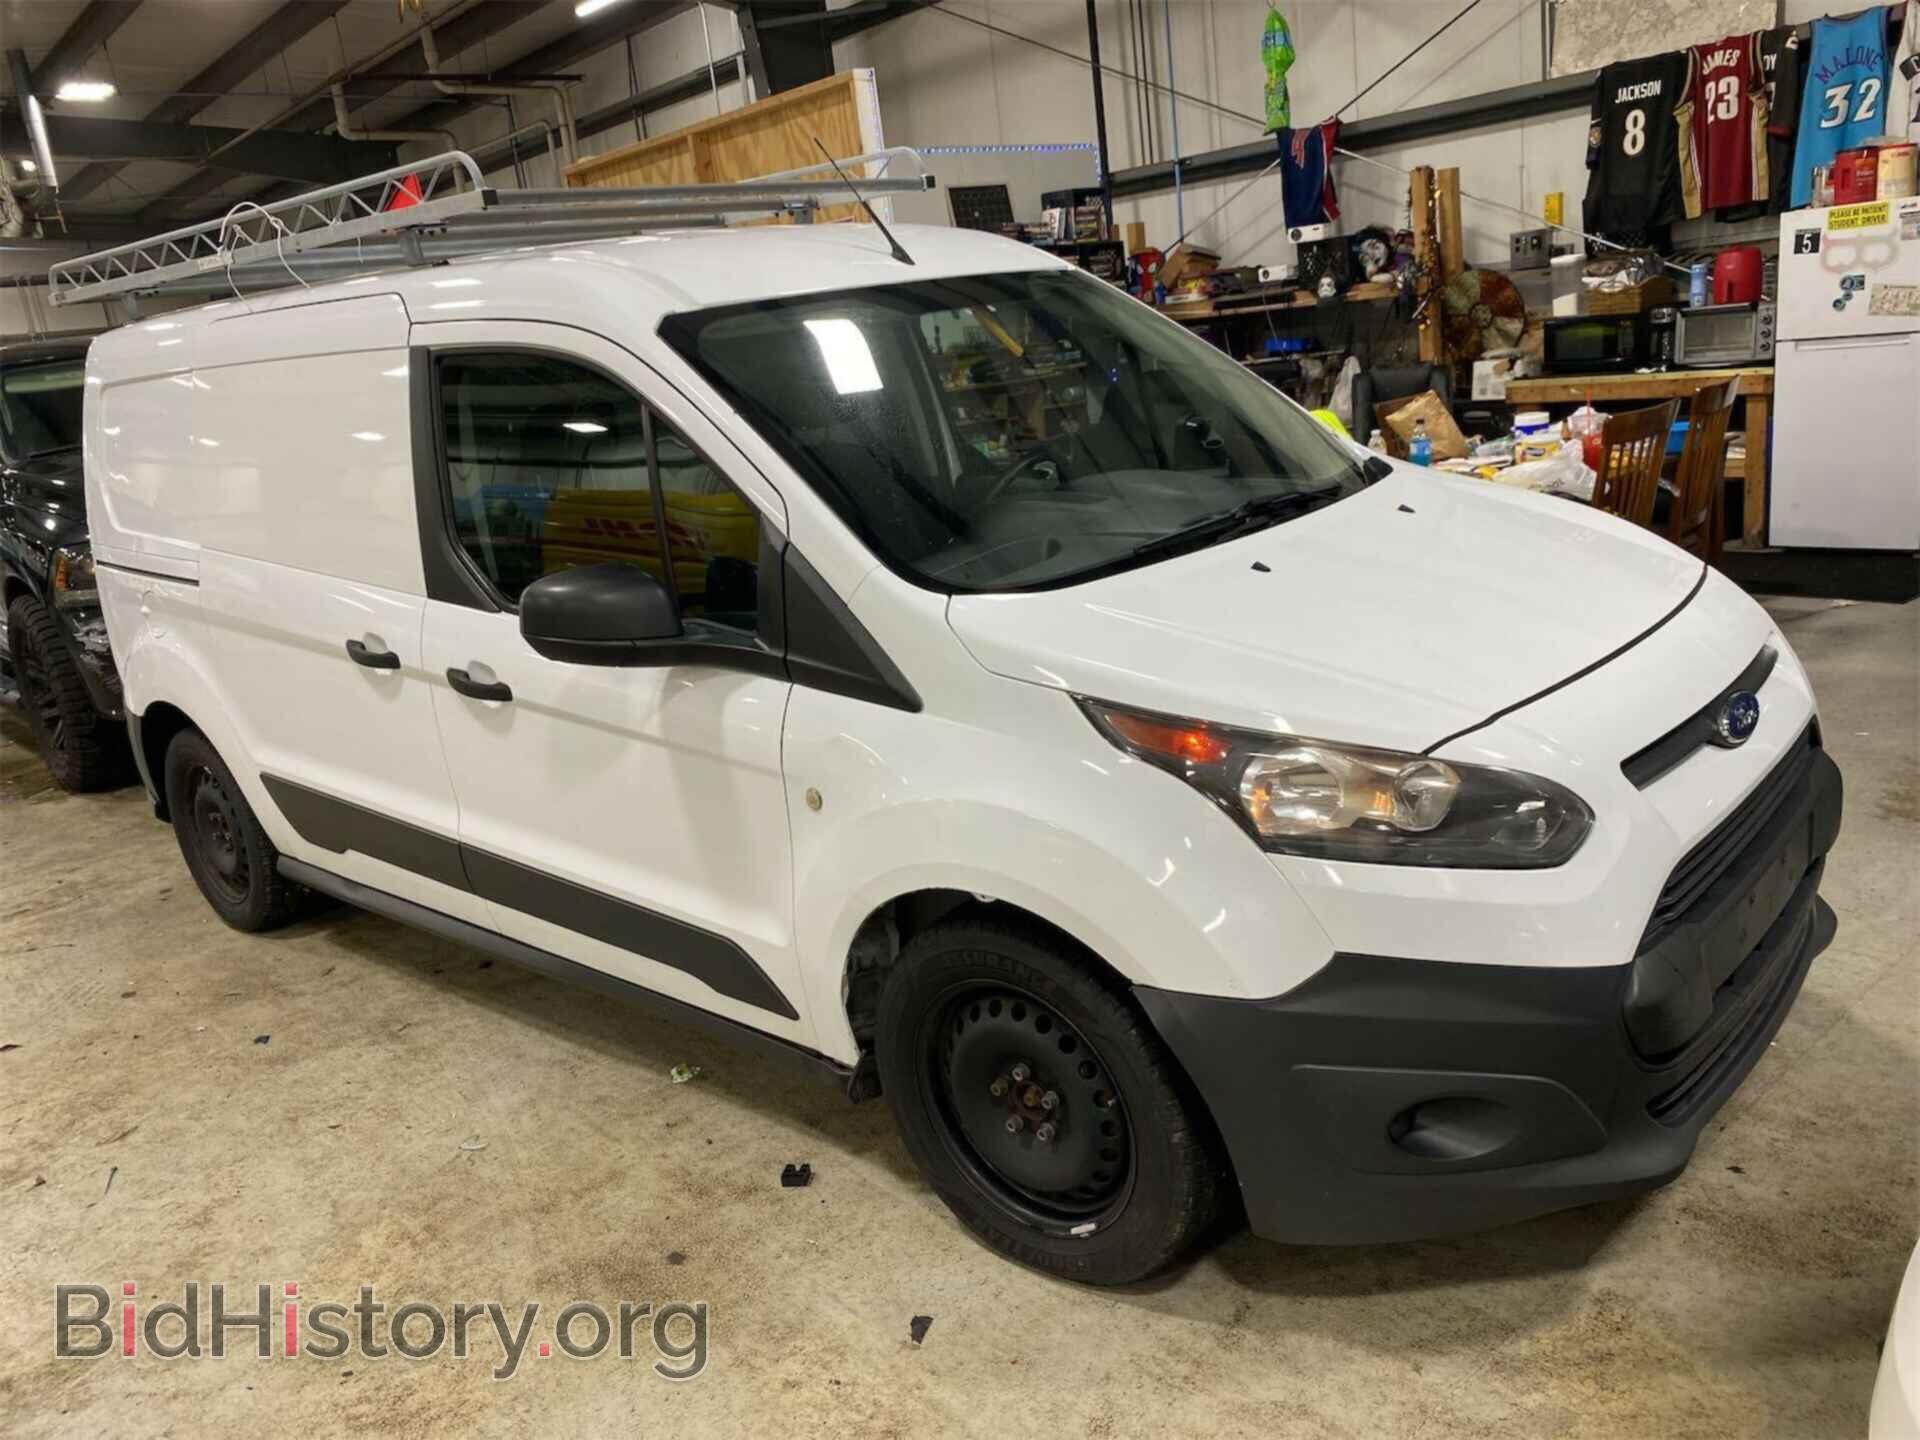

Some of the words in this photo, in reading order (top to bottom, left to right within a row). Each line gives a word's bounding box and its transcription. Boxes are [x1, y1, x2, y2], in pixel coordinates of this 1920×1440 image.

[1702, 49, 1741, 75] JAMES
[1815, 47, 1882, 84] MALONE
[1614, 79, 1662, 104] JACKSON
[1705, 75, 1740, 125] 23
[1819, 78, 1883, 129] 32
[1622, 108, 1647, 157] 8
[1829, 217, 1858, 230] STUDENT
[1862, 214, 1887, 226] DRIVER
[1830, 208, 1852, 219] PLEASE
[1862, 204, 1888, 215] PATIENT
[1801, 233, 1813, 253] 5
